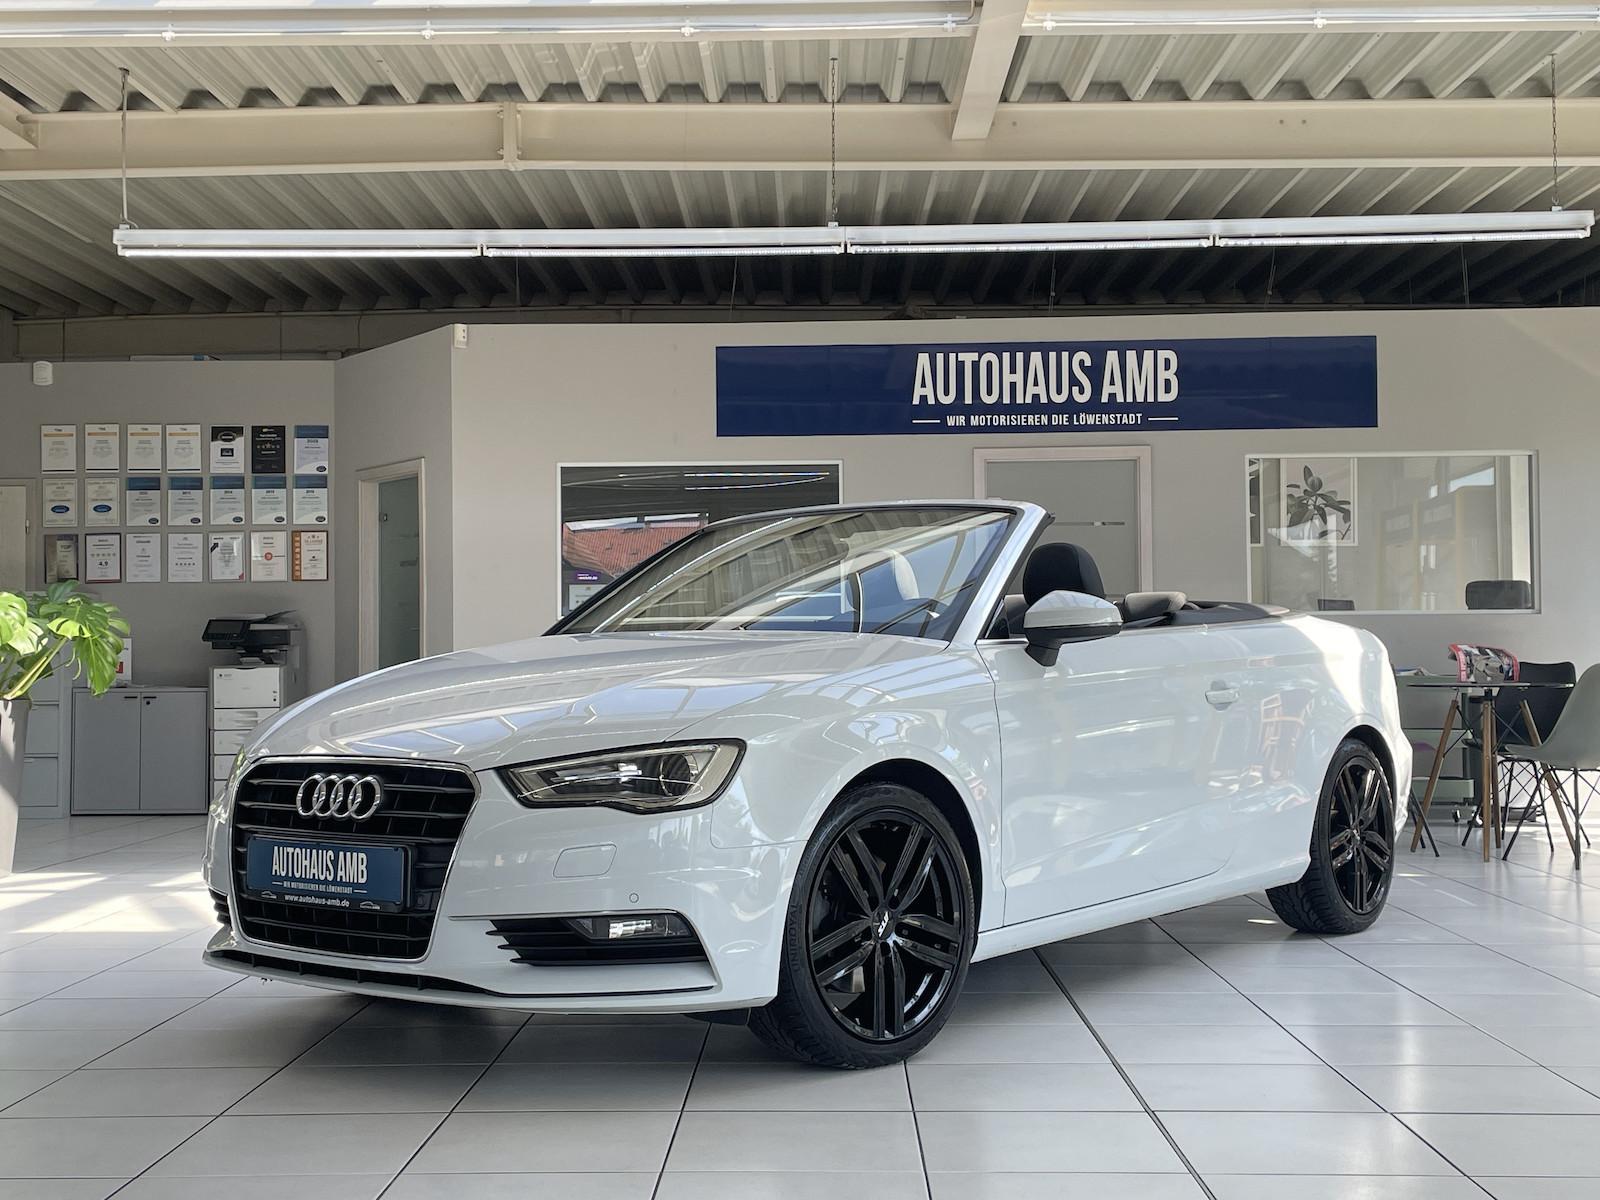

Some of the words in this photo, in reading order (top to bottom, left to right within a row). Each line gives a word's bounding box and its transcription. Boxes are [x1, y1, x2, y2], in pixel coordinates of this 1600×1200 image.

[912, 351, 1092, 405] AUTOHAUS
[1101, 349, 1179, 403] AMB
[946, 415, 966, 427] WIR
[970, 414, 1048, 426] MOTORISIEREN
[1052, 414, 1069, 426] DIE
[1073, 412, 1143, 425] LÖWENSTADT
[272, 846, 334, 881] AUTOHAUS
[337, 851, 368, 884] AMB
[284, 894, 350, 907] www.autohaus-amb.de
